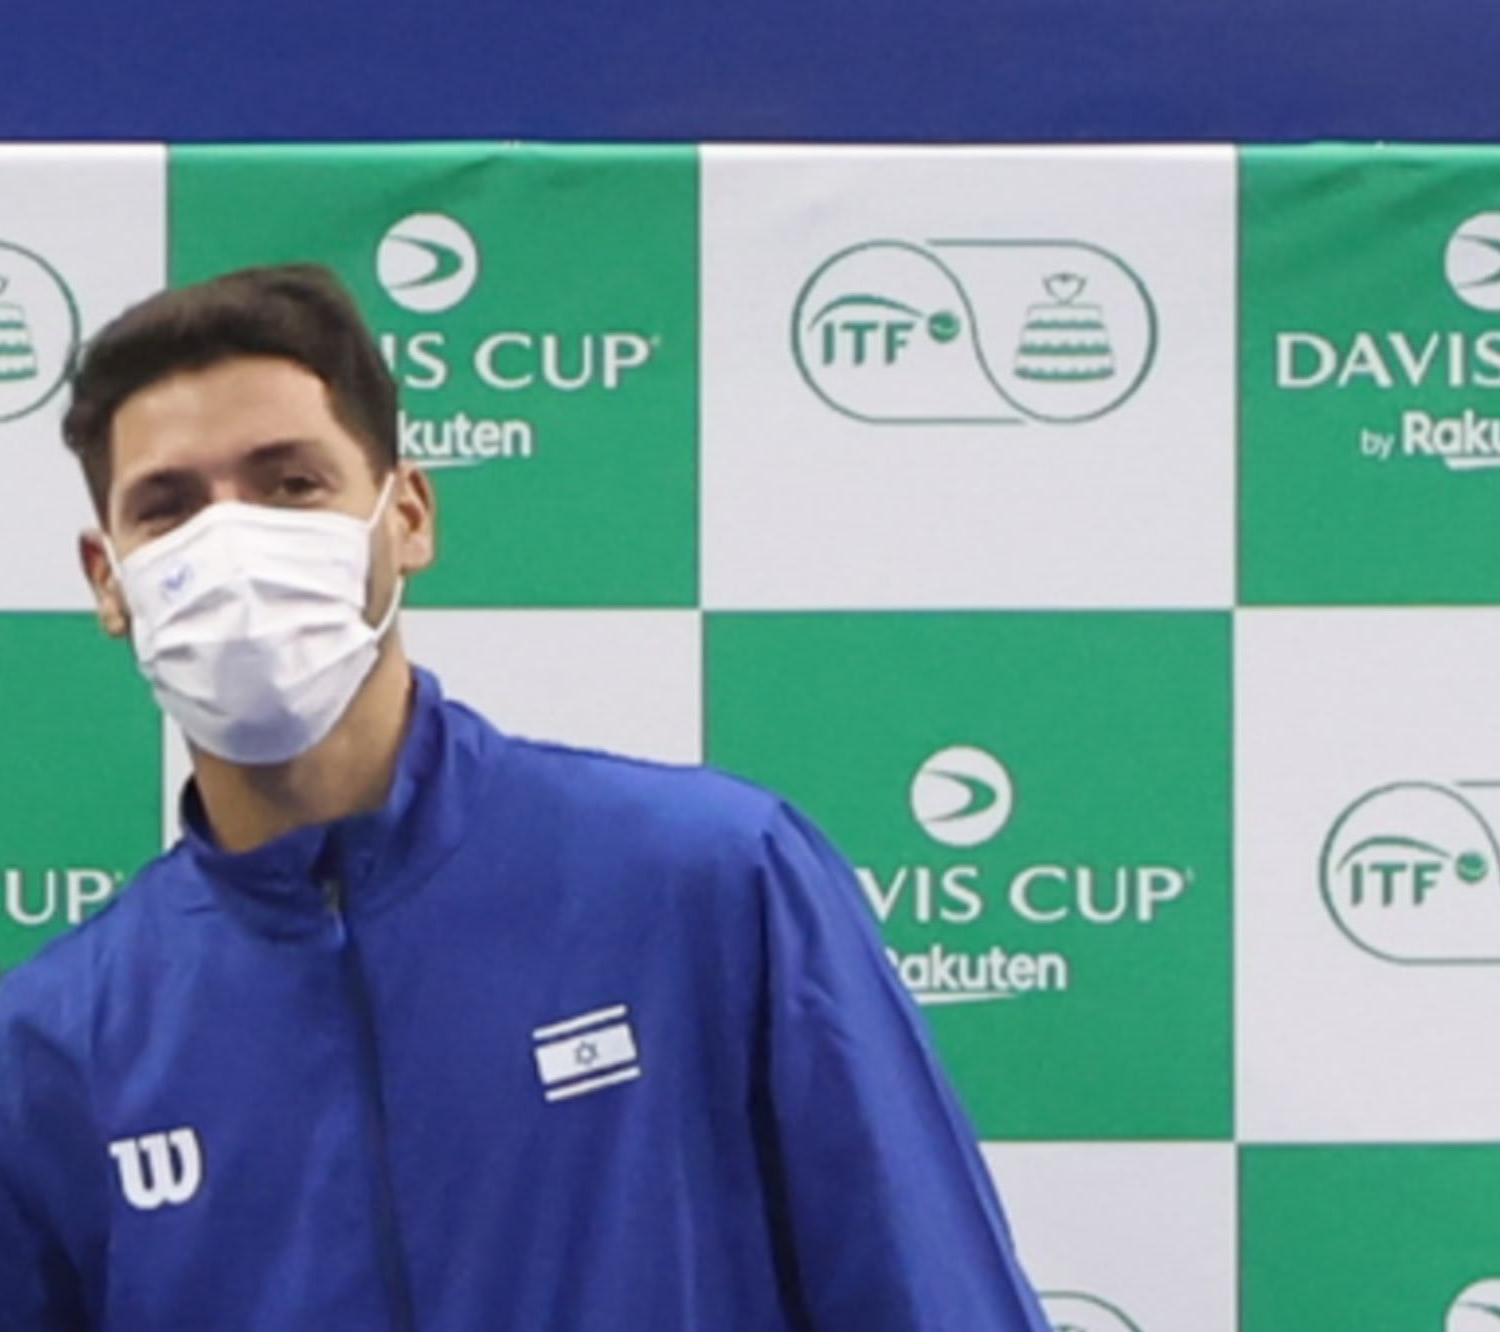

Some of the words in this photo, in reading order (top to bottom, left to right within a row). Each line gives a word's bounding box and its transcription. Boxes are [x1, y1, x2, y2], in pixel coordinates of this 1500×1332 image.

[475, 333, 650, 390] CUP
[821, 319, 916, 366] ITF
[398, 410, 532, 457] kuten
[1360, 429, 1395, 461] by
[854, 865, 984, 923] VIS
[1009, 865, 1185, 923] CUP
[1351, 862, 1443, 906] ITF
[884, 944, 1068, 992] akuten
